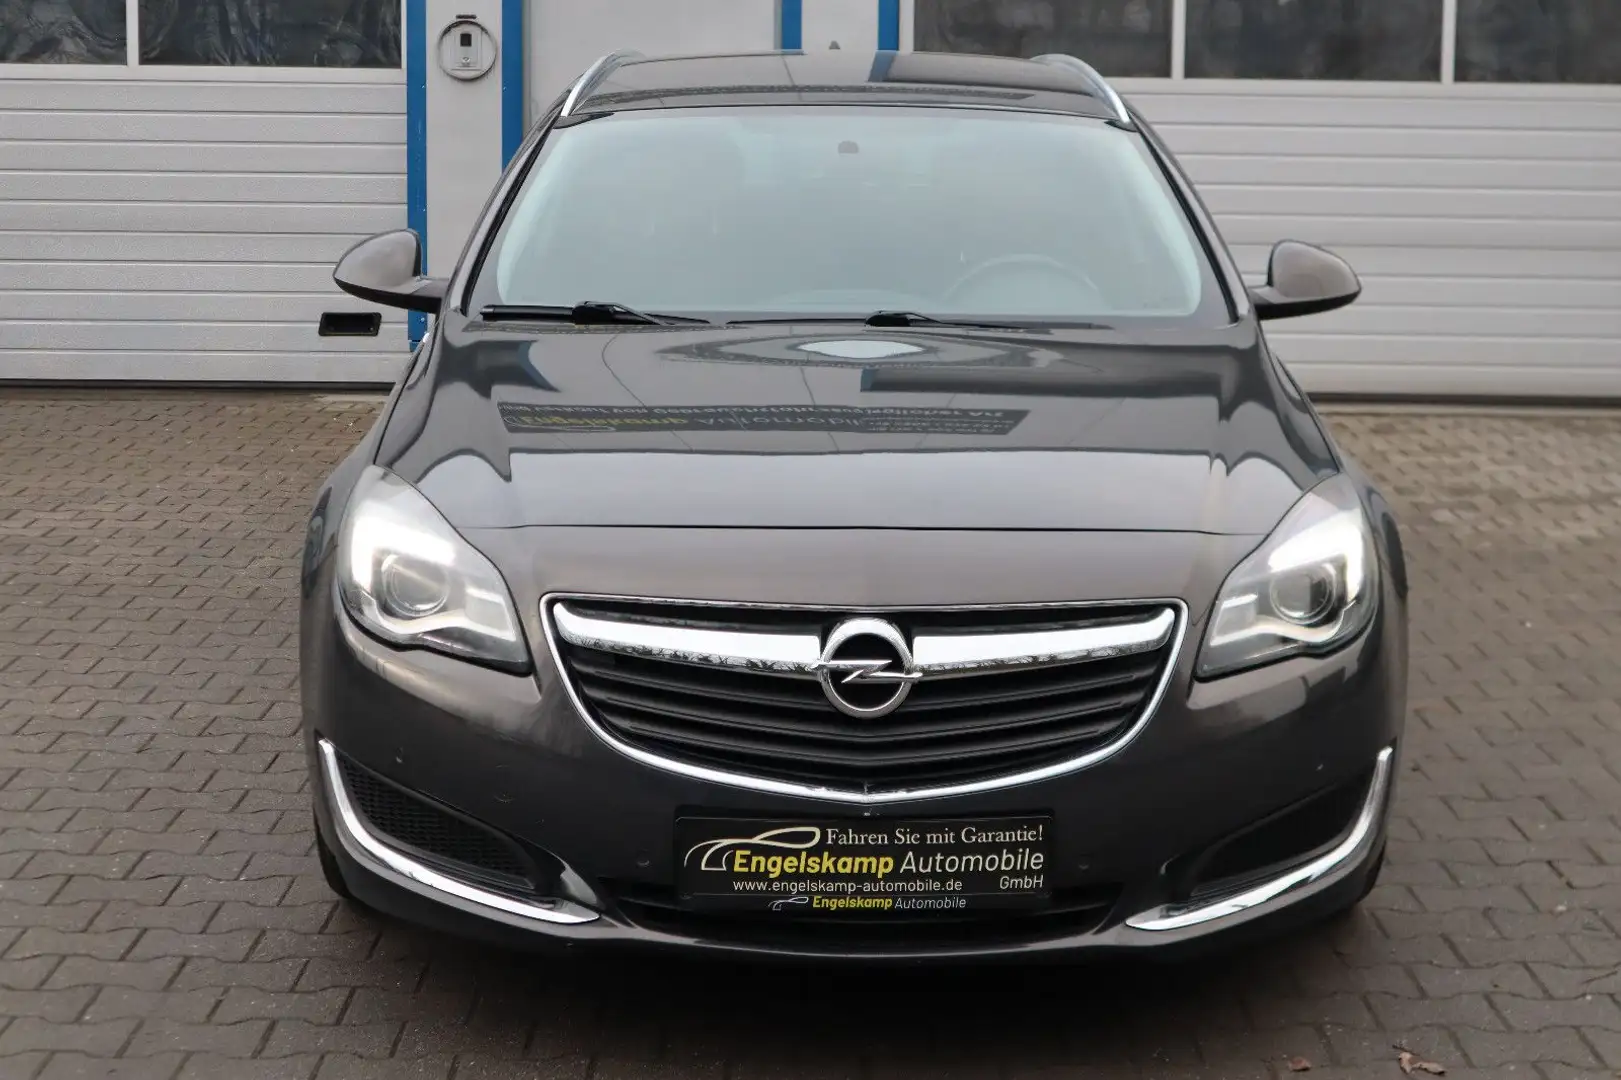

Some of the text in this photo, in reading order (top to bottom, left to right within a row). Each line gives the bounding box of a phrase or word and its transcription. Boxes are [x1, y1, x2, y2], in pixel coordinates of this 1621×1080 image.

[825, 824, 1044, 845] Fahren Sie mit Garantie!
[733, 848, 1044, 878] Engelskamp Automobile
[732, 878, 963, 895] www.engelskamp-automobile.de
[999, 874, 1044, 890] GmbH
[812, 895, 967, 911] Engelskamp Automobile
